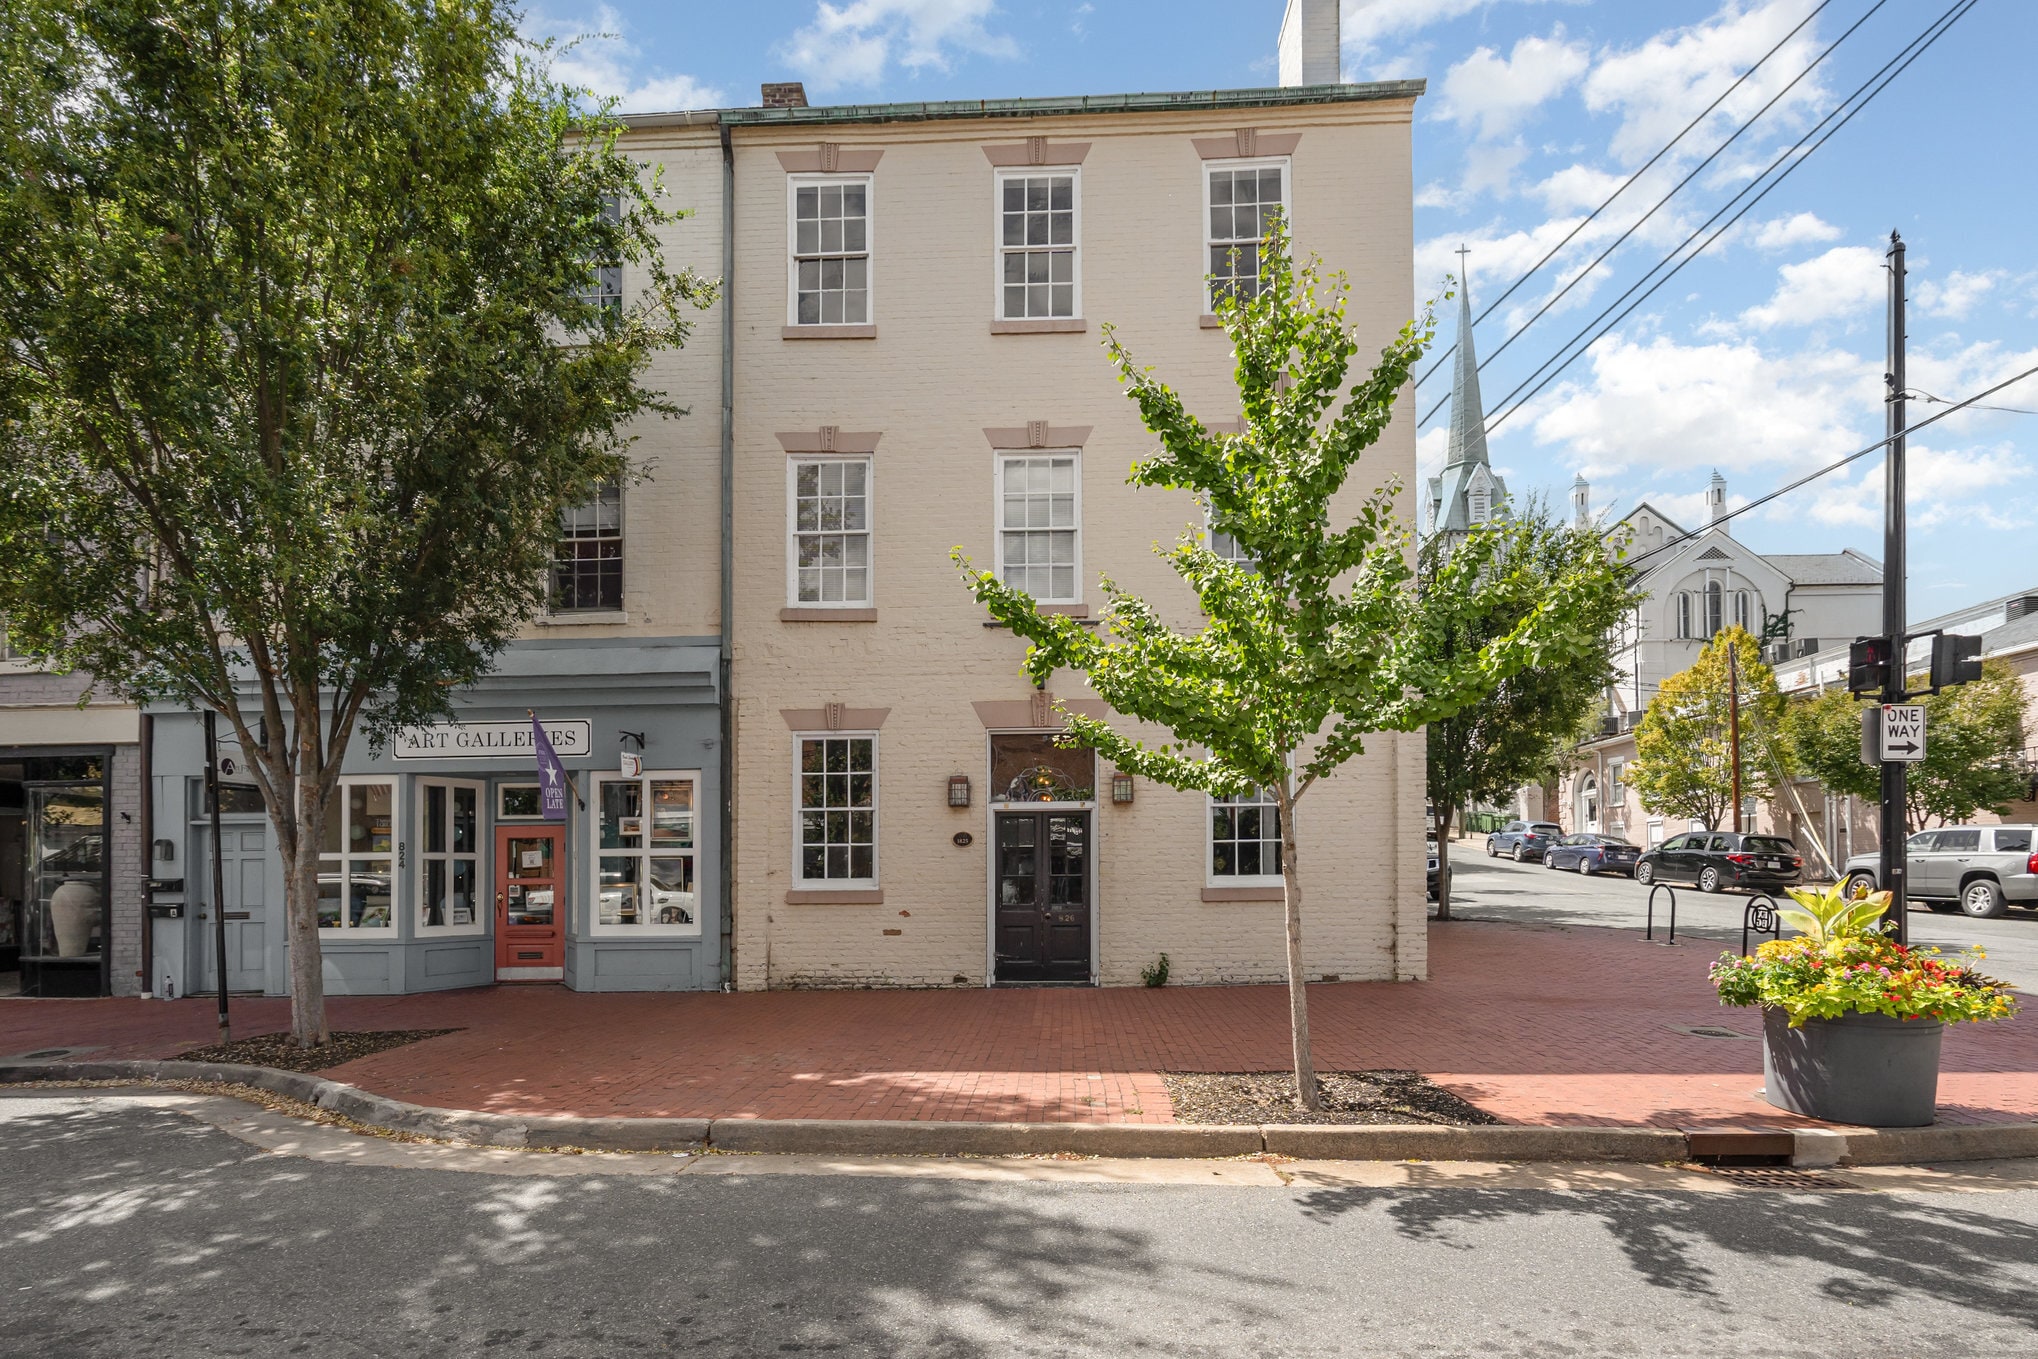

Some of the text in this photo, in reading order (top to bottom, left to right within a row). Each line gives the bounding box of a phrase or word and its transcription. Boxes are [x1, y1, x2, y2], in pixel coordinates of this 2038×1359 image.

[1887, 709, 1919, 722] ONE
[1888, 724, 1920, 738] WAY
[408, 730, 576, 749] ART GALLEES
[545, 787, 563, 798] OPEN
[546, 798, 564, 809] LATE
[398, 842, 406, 869] 824
